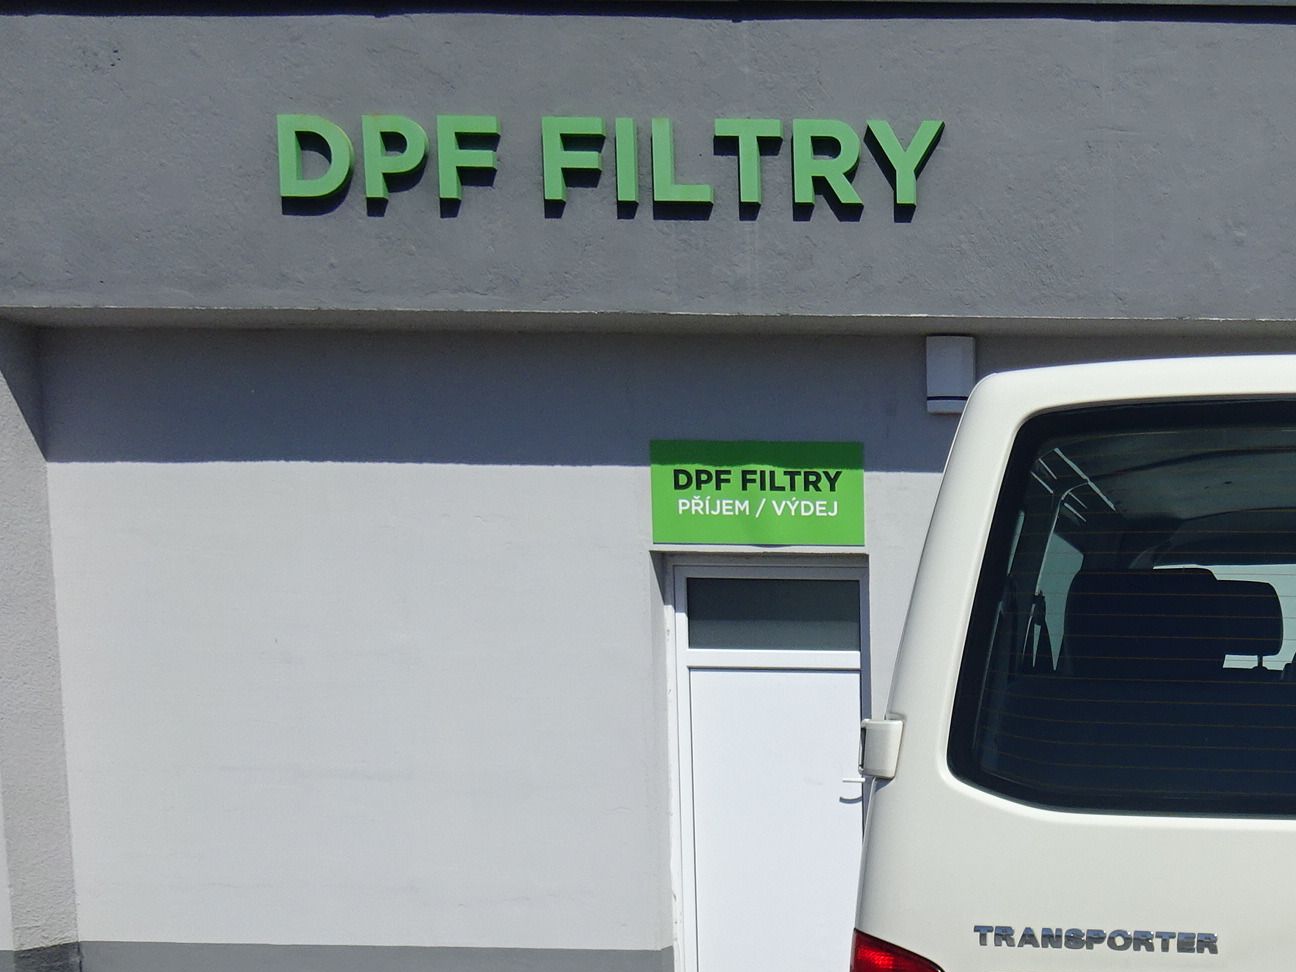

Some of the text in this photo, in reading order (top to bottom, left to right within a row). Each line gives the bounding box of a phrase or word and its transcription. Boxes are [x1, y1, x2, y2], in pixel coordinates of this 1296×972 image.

[276, 113, 945, 206] DPF FILTRY
[672, 468, 843, 493] DPF FILTRY
[677, 495, 750, 516] PŘÍJEM
[771, 496, 838, 517] VÝDEJ
[973, 924, 1219, 955] TRANSPORTER
